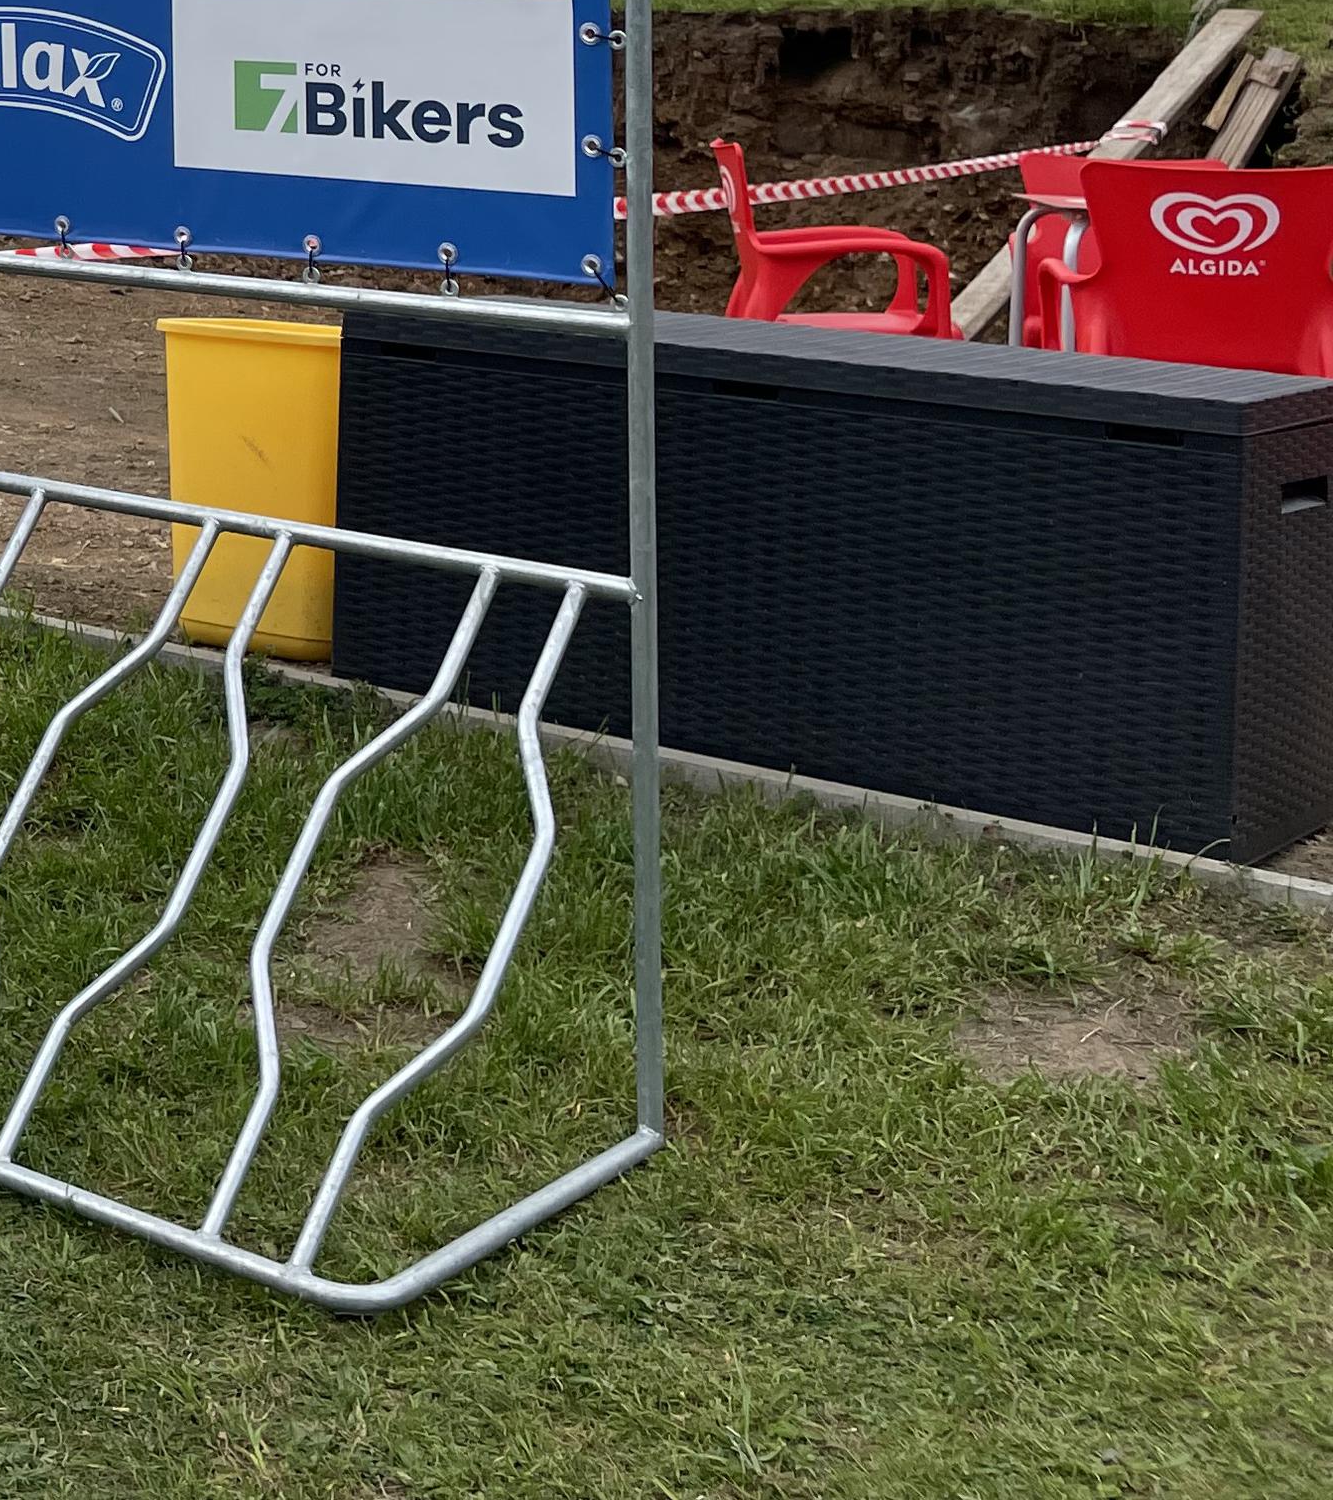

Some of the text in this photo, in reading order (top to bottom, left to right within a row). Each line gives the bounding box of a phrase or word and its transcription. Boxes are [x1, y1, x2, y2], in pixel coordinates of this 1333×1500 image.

[304, 63, 341, 77] FOR
[305, 80, 525, 148] Bikers
[1170, 258, 1259, 277] ALGIDA
